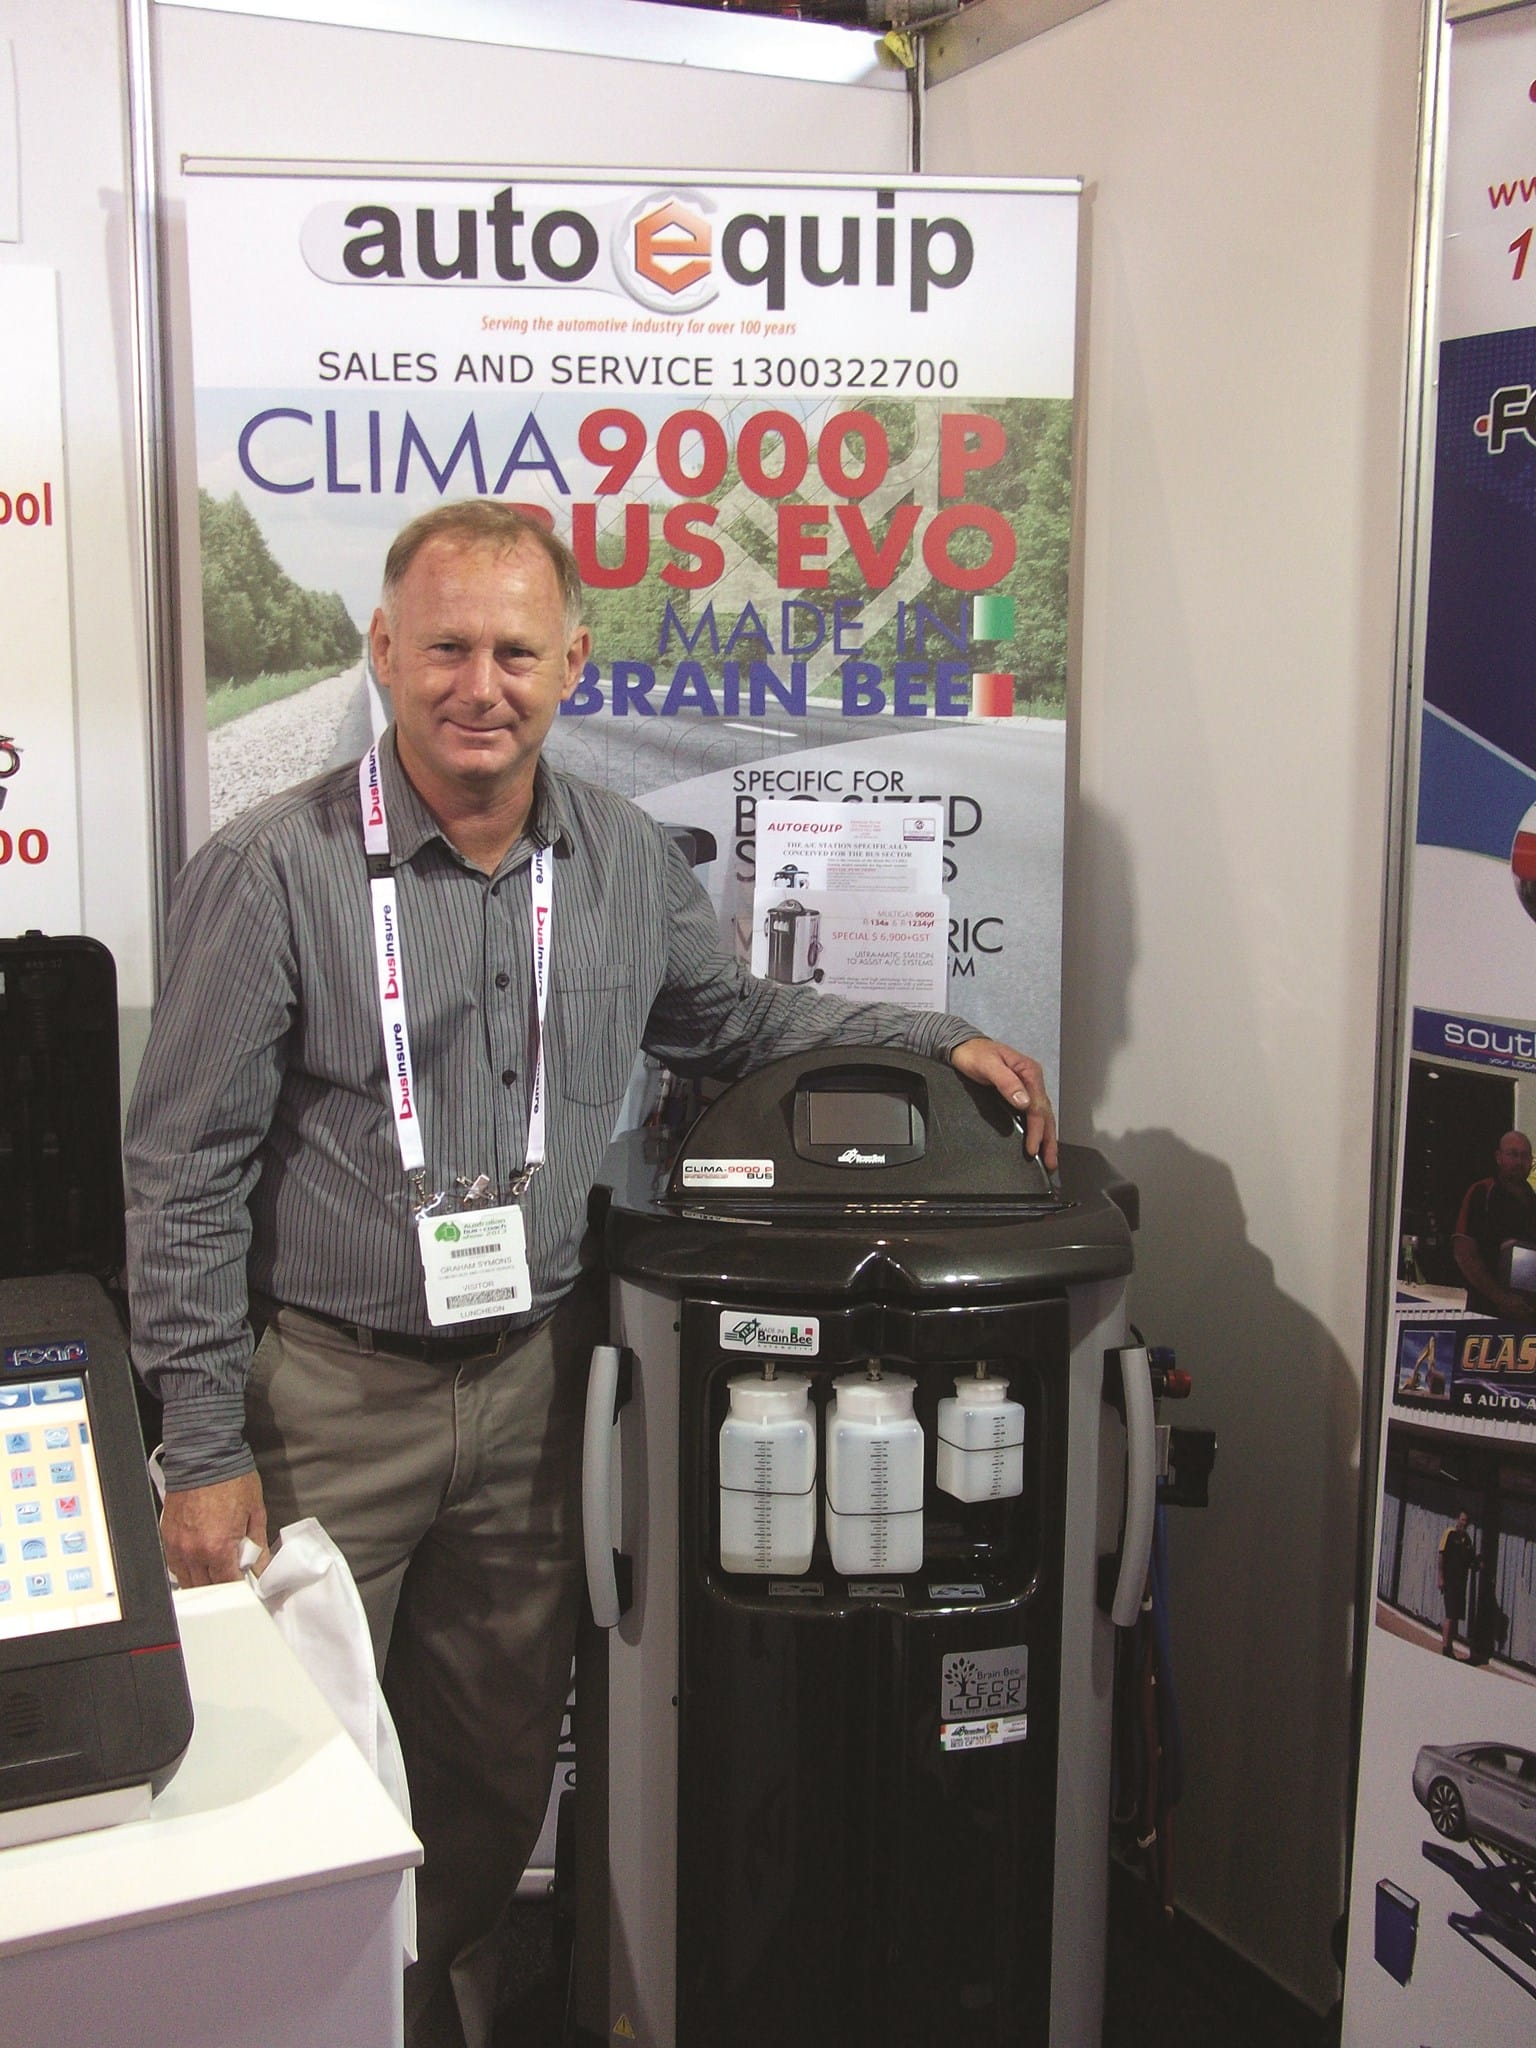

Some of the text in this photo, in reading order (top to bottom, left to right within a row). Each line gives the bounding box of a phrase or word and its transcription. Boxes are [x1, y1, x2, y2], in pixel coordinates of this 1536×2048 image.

[481, 315, 796, 338] Serving the automotive industry for over 100 years
[318, 351, 959, 389] SALES AND SERVICE 1300322700
[238, 408, 1007, 498] CLIMA 9000 P
[500, 503, 1018, 591] US EVO
[658, 599, 969, 656] MADE IN
[559, 661, 970, 717] BRAIN BEE
[733, 770, 905, 793] SPECIFIC FOR
[767, 822, 844, 835] AUTOEQUIP
[819, 842, 851, 850] STATION
[832, 931, 869, 941] SPECIAL
[903, 951, 934, 960] STATION
[1444, 1022, 1536, 1058] sout
[463, 1280, 495, 1291] VISITOR
[460, 1304, 506, 1319] LUNCHEON
[1477, 1394, 1520, 1408] AUTO
[977, 1667, 1019, 1680] Brain Bee
[977, 1678, 1021, 1696] ECO
[949, 1690, 1020, 1712] LOCK
